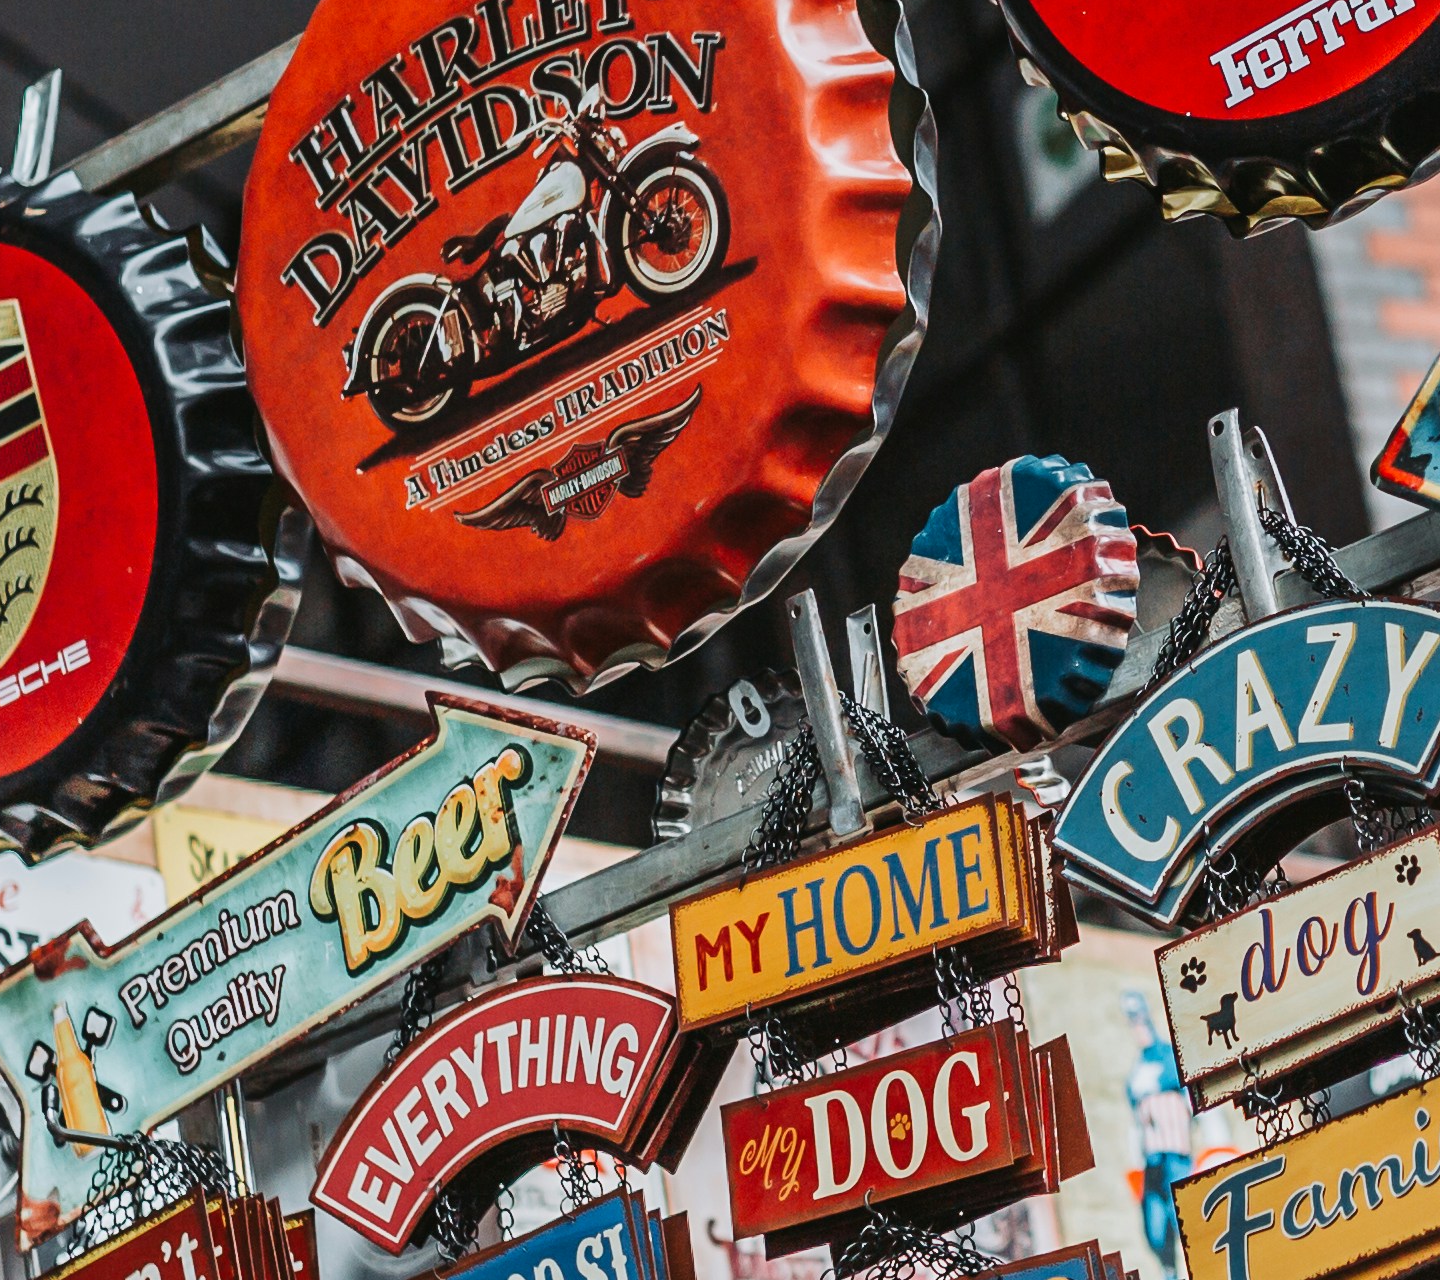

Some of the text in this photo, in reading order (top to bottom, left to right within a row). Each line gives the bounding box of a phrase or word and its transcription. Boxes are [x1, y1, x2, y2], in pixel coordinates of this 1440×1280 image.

[280, 32, 724, 327] DAVIDSON
[404, 308, 730, 510] A Timeless TRADITION
[547, 454, 624, 507] HARLEY-DAVIDSON
[311, 745, 532, 973] Beer
[694, 822, 991, 993] MY HOME
[119, 890, 299, 1029] Premium
[165, 964, 287, 1075] Quality
[1239, 887, 1395, 1003] dog
[346, 1014, 640, 1226] EVERYTHING
[803, 1048, 994, 1202] DOG
